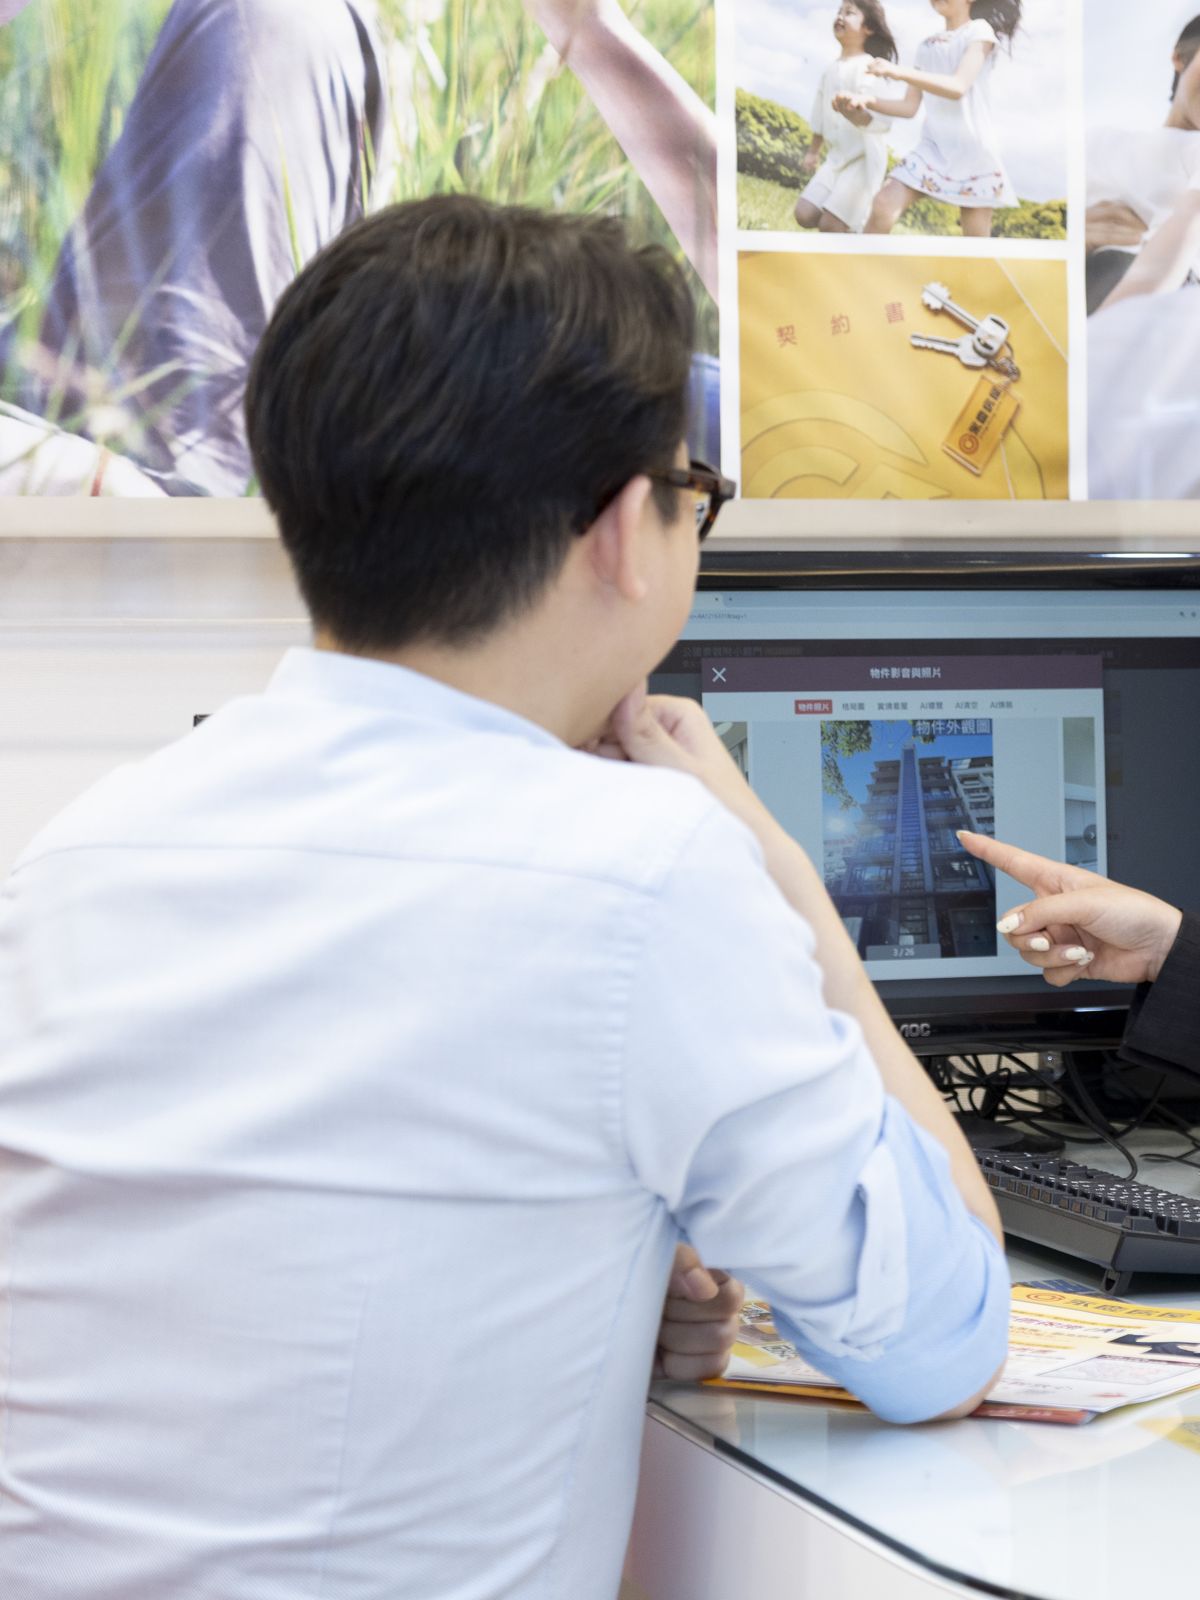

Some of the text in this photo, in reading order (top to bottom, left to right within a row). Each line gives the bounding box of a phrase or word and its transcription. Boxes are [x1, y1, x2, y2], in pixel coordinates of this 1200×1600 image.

[776, 301, 905, 347] 契約書
[869, 666, 942, 679] 物件影音與照片
[915, 719, 992, 735] 物件外觀圖
